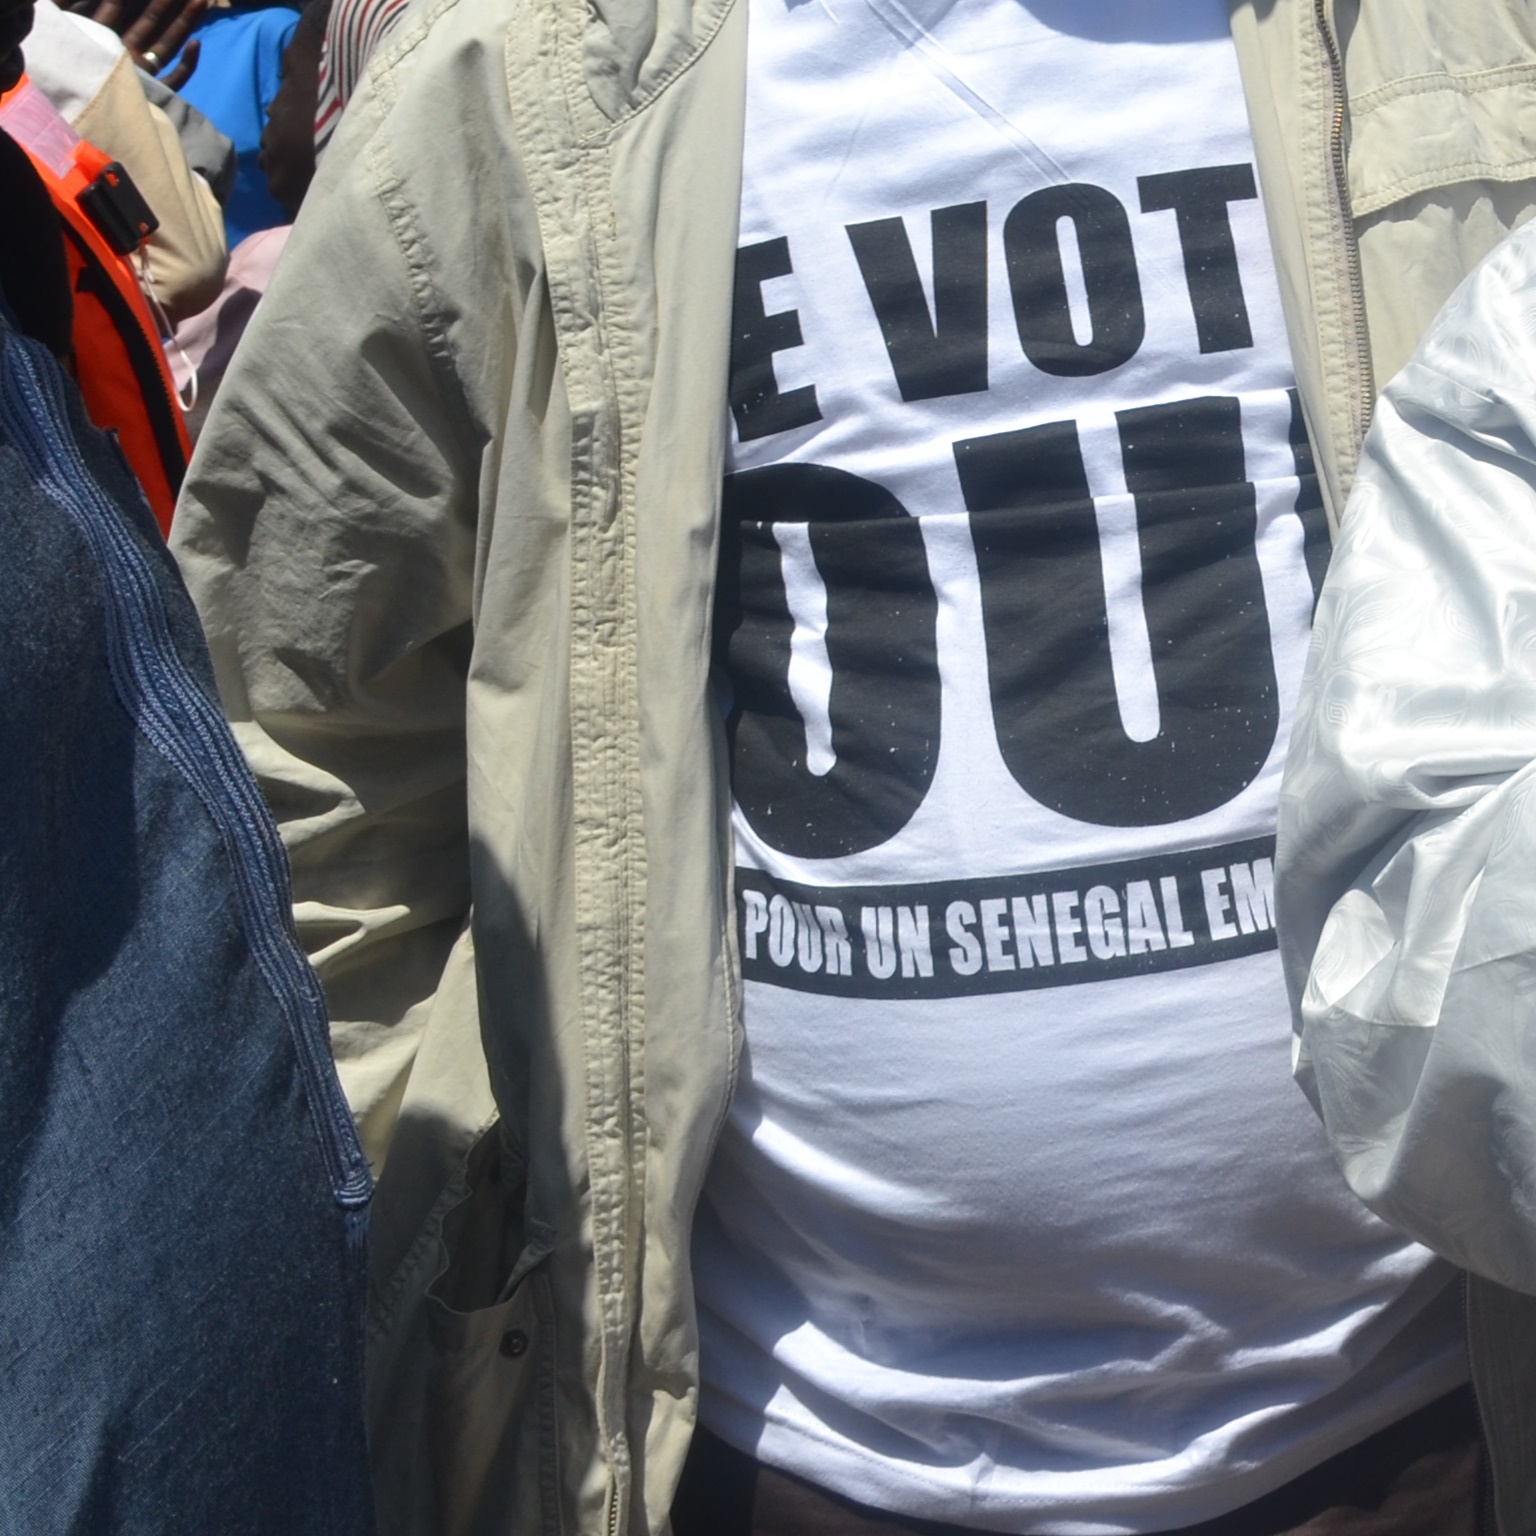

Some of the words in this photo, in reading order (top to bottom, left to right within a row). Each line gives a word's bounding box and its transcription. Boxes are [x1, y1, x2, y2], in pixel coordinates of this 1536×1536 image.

[742, 889, 852, 976] POUR
[860, 905, 934, 979] UN
[945, 875, 1196, 975] SENEGAL
